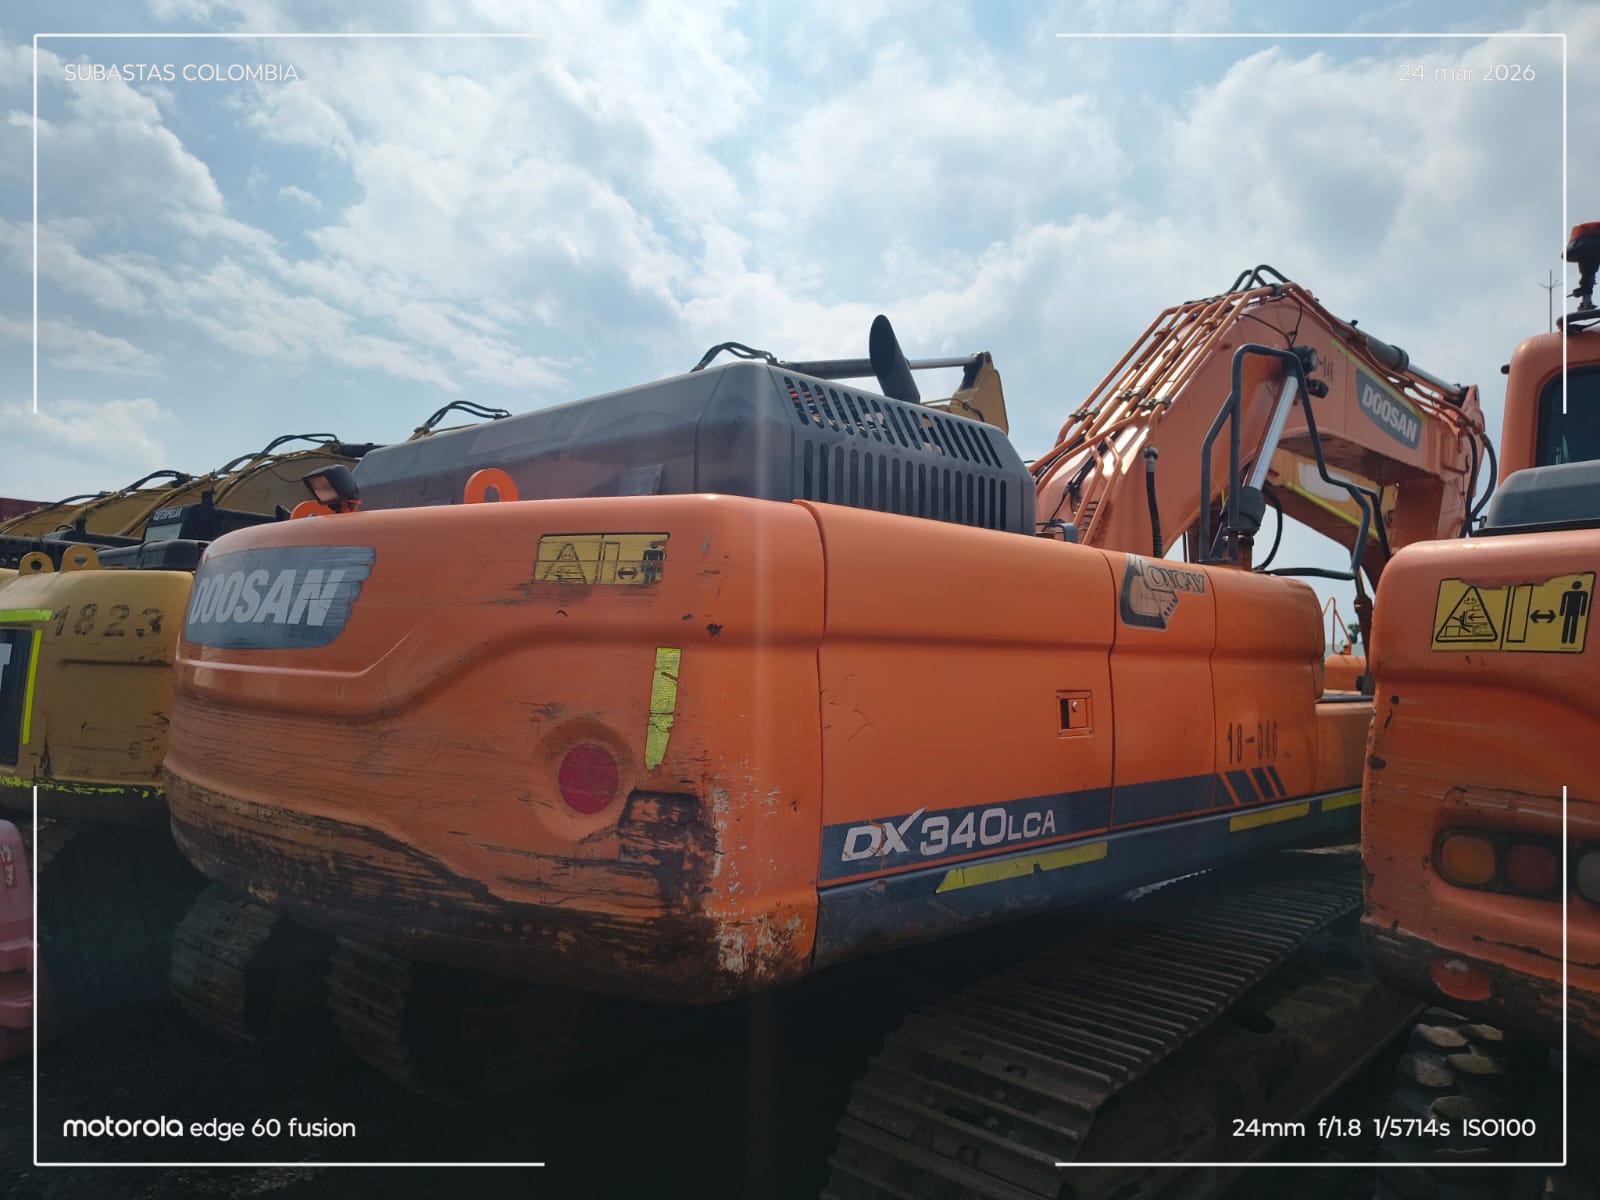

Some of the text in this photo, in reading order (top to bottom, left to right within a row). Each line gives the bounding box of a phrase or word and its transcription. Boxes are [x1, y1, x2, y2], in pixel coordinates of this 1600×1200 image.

[1361, 384, 1418, 442] DOOSAN
[53, 603, 165, 638] 1823
[188, 569, 346, 626] DOOSAN
